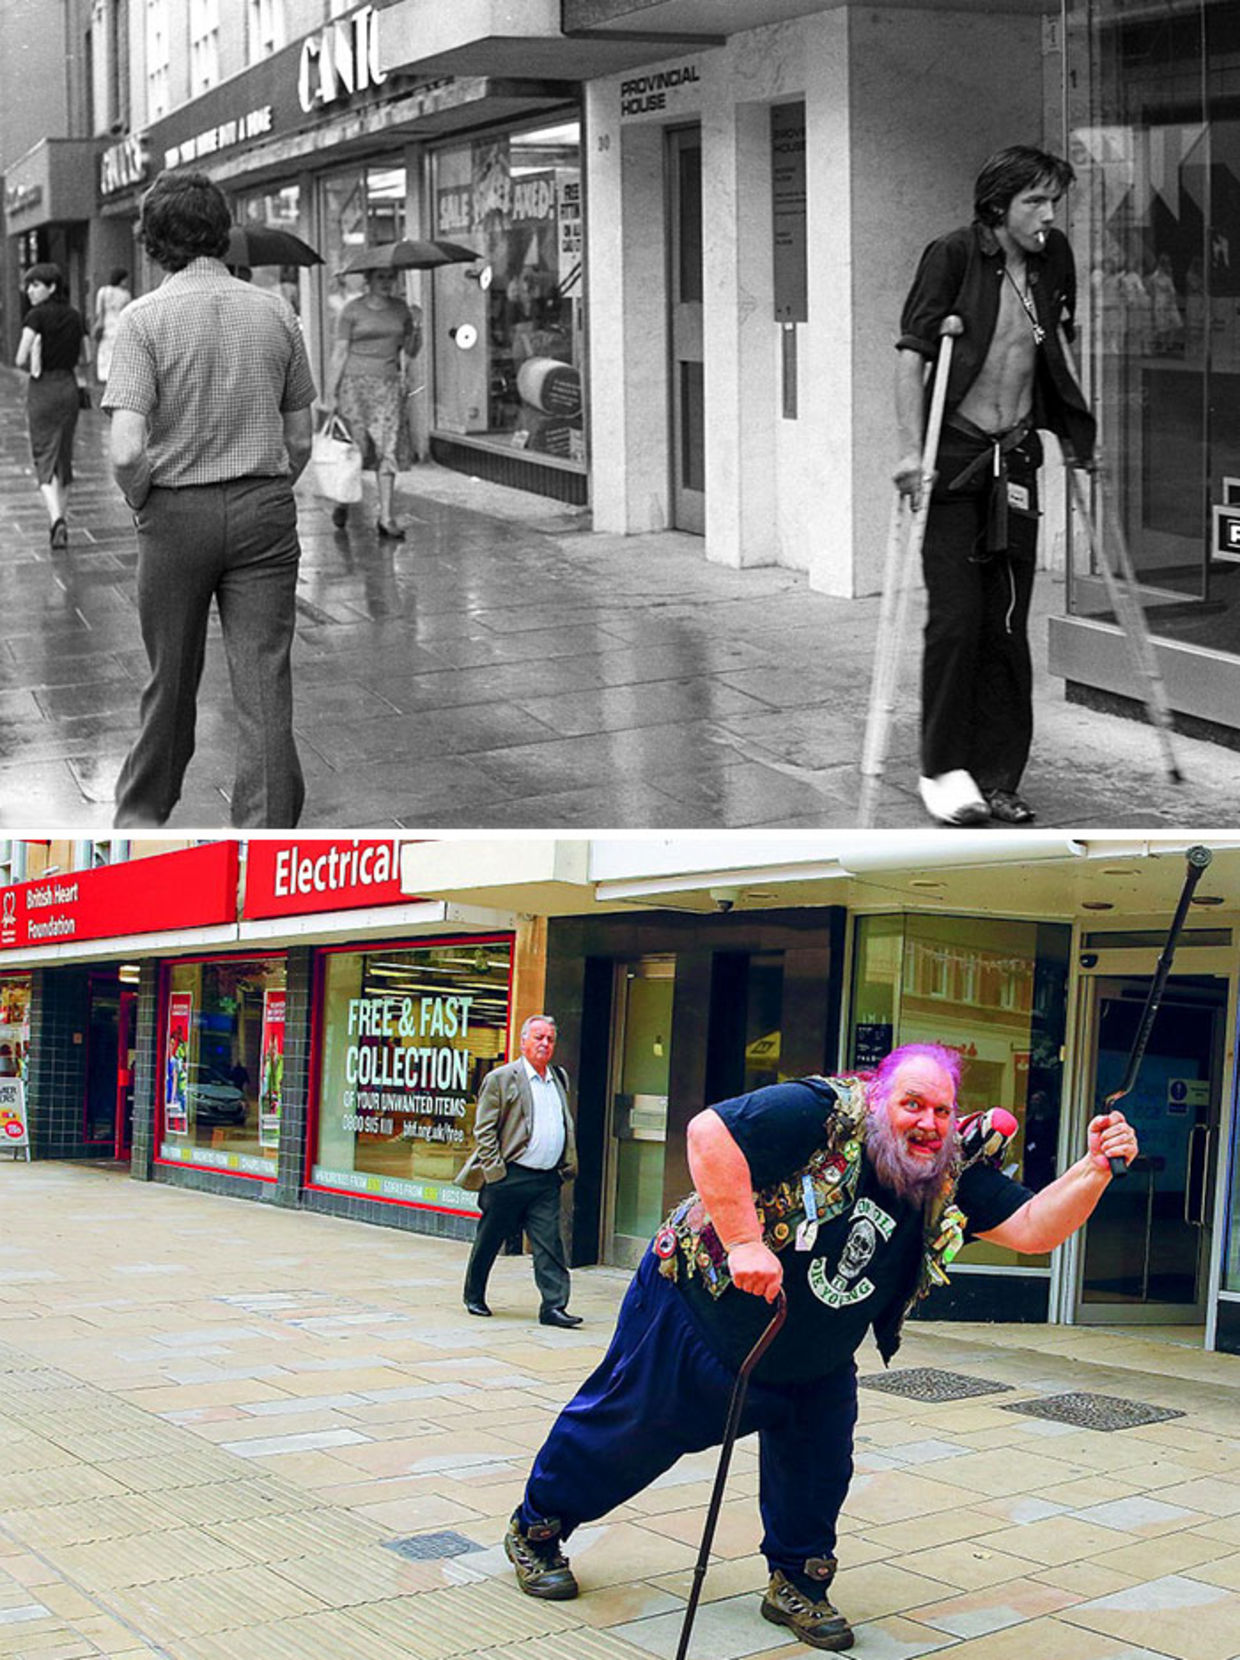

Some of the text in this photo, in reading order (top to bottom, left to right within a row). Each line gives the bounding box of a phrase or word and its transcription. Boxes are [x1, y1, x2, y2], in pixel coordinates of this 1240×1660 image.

[621, 66, 700, 98] PROVINCIAL
[621, 93, 667, 116] HOUSE
[274, 839, 400, 898] Electrical
[27, 882, 79, 910] British Heart
[28, 914, 76, 940] Foundation
[348, 996, 473, 1038] FREE & FAST
[346, 1045, 468, 1091] COLLECTION
[343, 1091, 467, 1118] OF YOUR UNWANTED ITEMS
